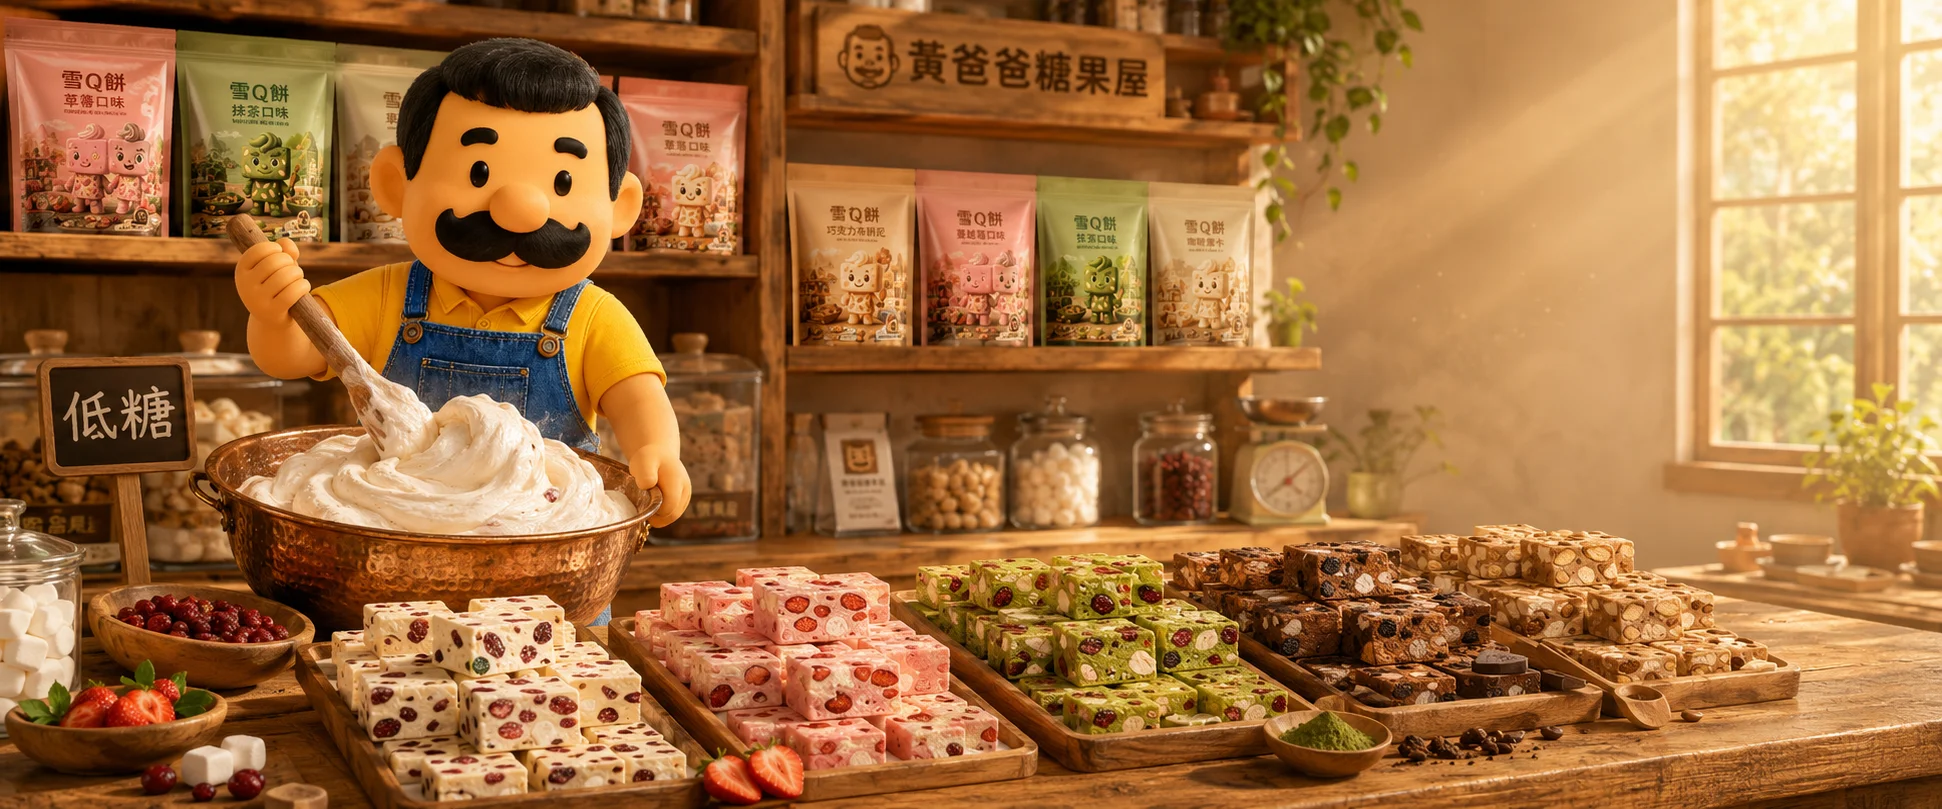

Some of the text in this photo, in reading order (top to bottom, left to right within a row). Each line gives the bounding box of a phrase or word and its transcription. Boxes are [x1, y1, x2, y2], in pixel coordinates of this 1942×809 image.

[908, 40, 1148, 97] 黃爸爸糖果屋
[62, 70, 126, 92] 雪Q餅
[230, 82, 289, 103] 雪Q餅
[662, 120, 710, 139] 雪Q餅
[830, 205, 880, 224] 雪Q餅
[957, 210, 1003, 228] 雪Q餅
[1074, 214, 1117, 232] 雪Q餅
[1184, 219, 1225, 236] 雪Q餅
[63, 385, 176, 442] 低糖
